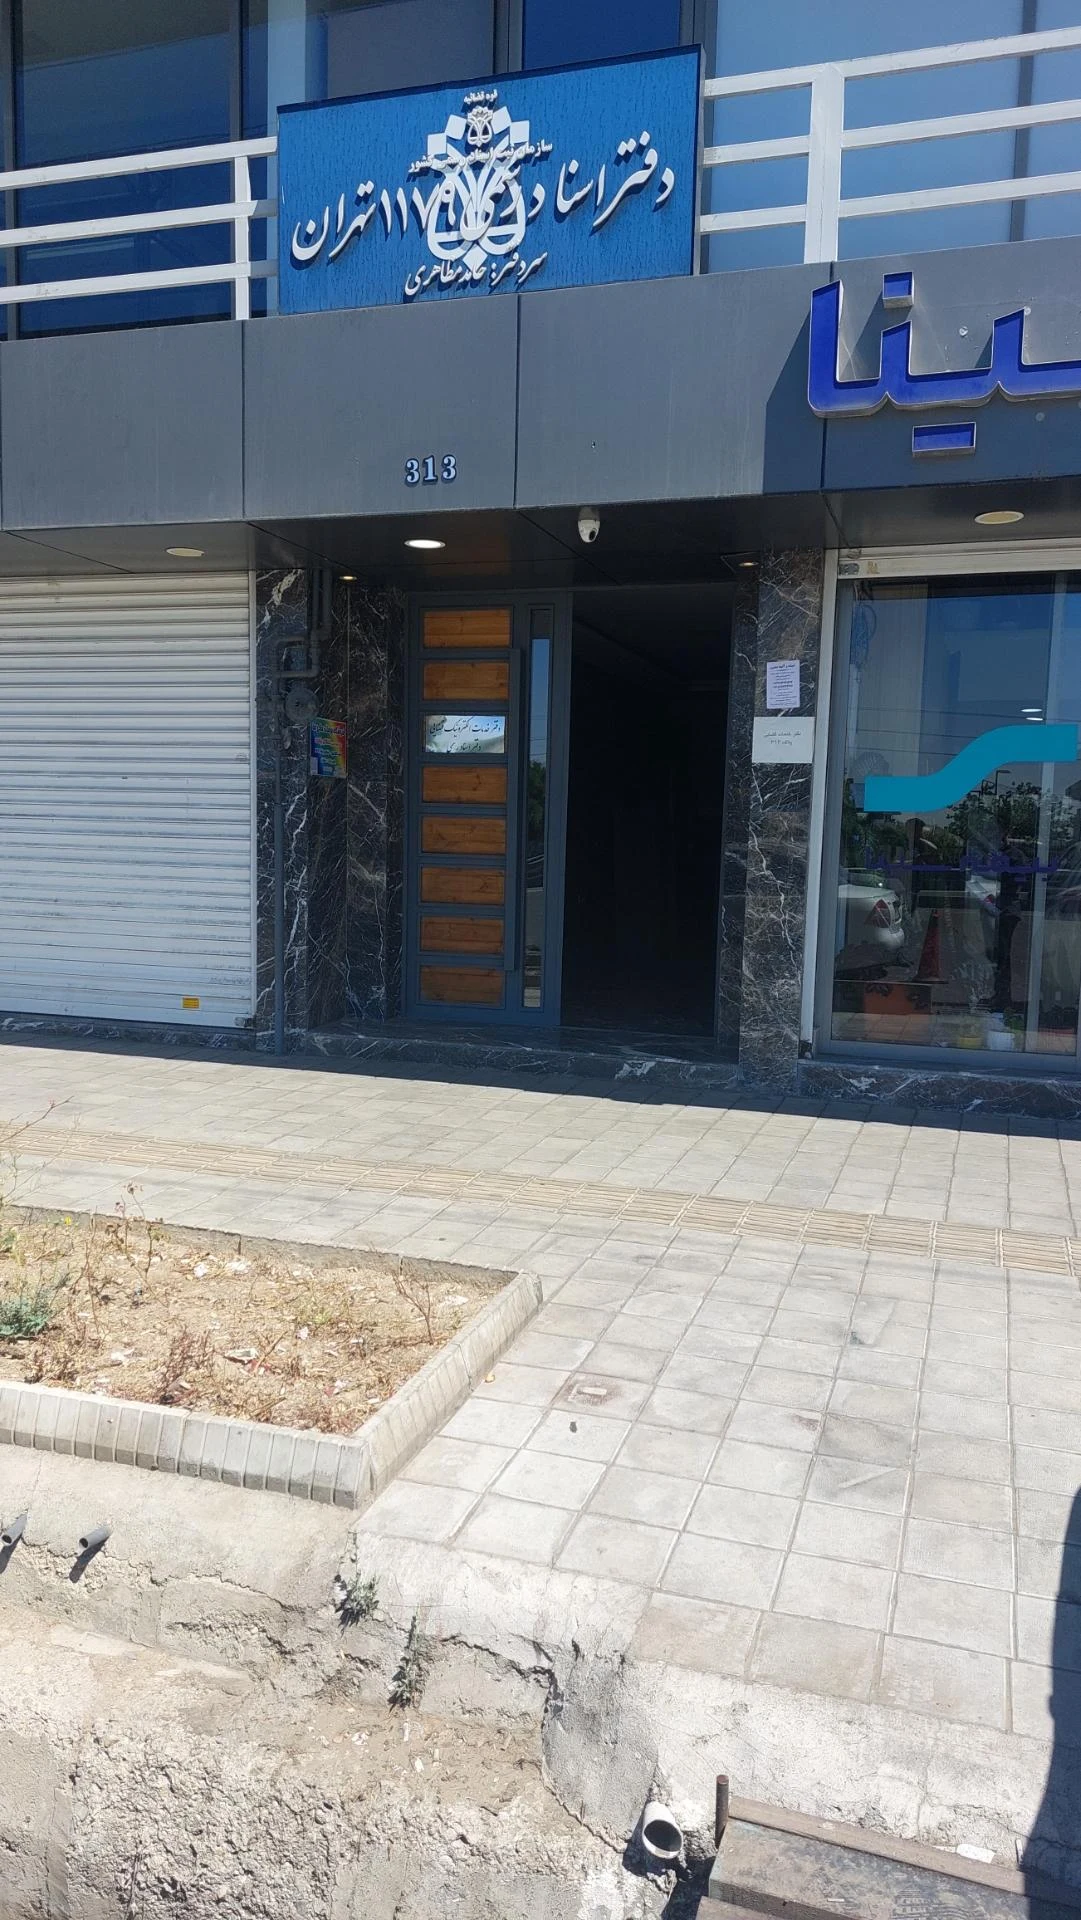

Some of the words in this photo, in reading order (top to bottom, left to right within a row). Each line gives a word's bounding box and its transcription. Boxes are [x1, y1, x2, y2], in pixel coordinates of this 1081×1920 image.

[408, 154, 435, 173] کشور
[515, 139, 552, 159] سازمان
[527, 159, 606, 218] اسناد
[592, 130, 675, 227] دفتر
[292, 180, 376, 261] تهران
[381, 180, 457, 234] ۱۱۷۹
[458, 263, 487, 282] حامد
[405, 455, 456, 483] 313
